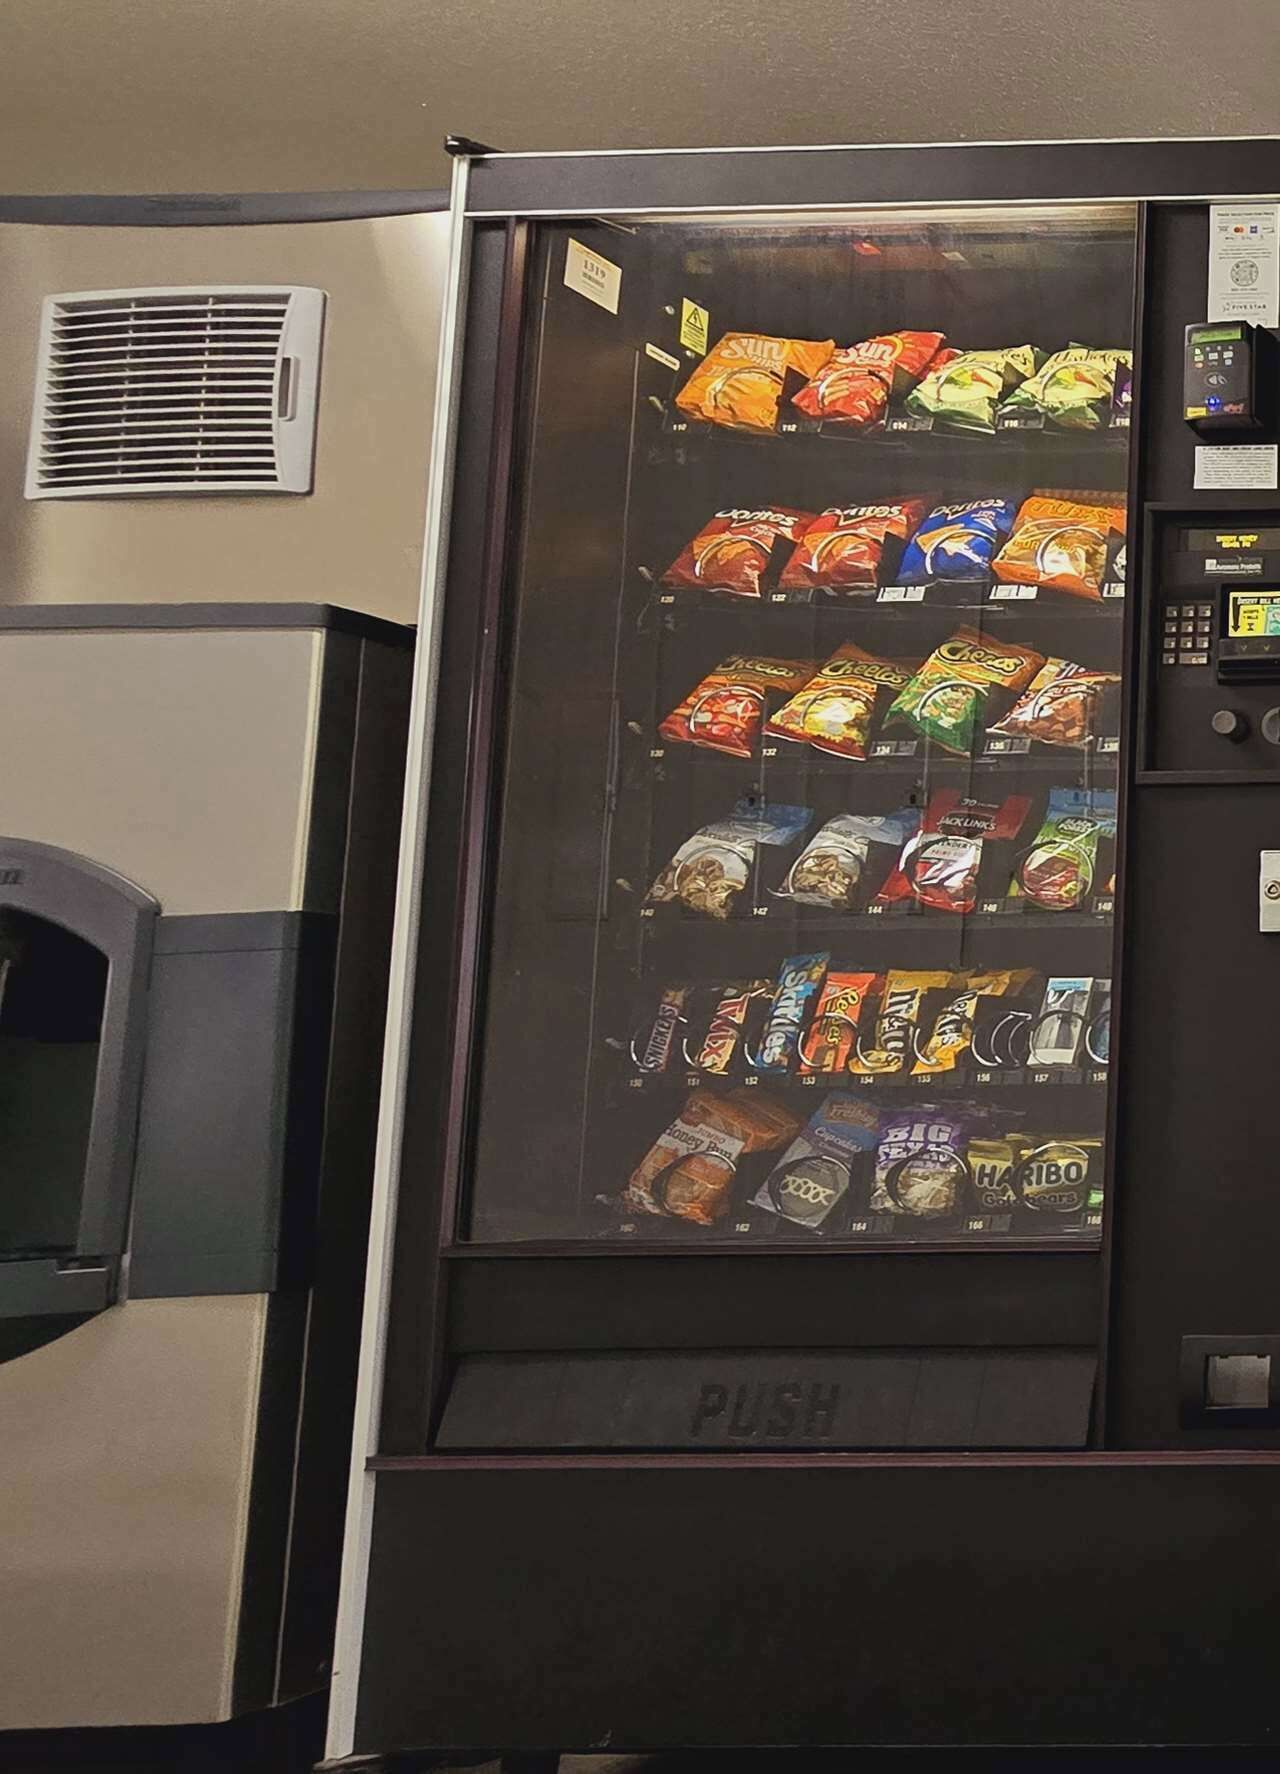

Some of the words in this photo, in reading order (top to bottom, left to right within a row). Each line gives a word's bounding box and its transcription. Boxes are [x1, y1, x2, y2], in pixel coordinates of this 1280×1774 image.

[720, 337, 785, 360] Sun
[838, 340, 894, 363] Sun
[715, 507, 800, 527] Doritos
[929, 497, 1006, 520] Doritos
[819, 658, 908, 686] Cheetos
[936, 815, 963, 827] JACK
[643, 1003, 680, 1068] SNICKES
[664, 1122, 705, 1151] Honey
[883, 1123, 954, 1144] BIG
[976, 1161, 1085, 1190] HARIBO
[690, 1382, 842, 1440] PUSH
